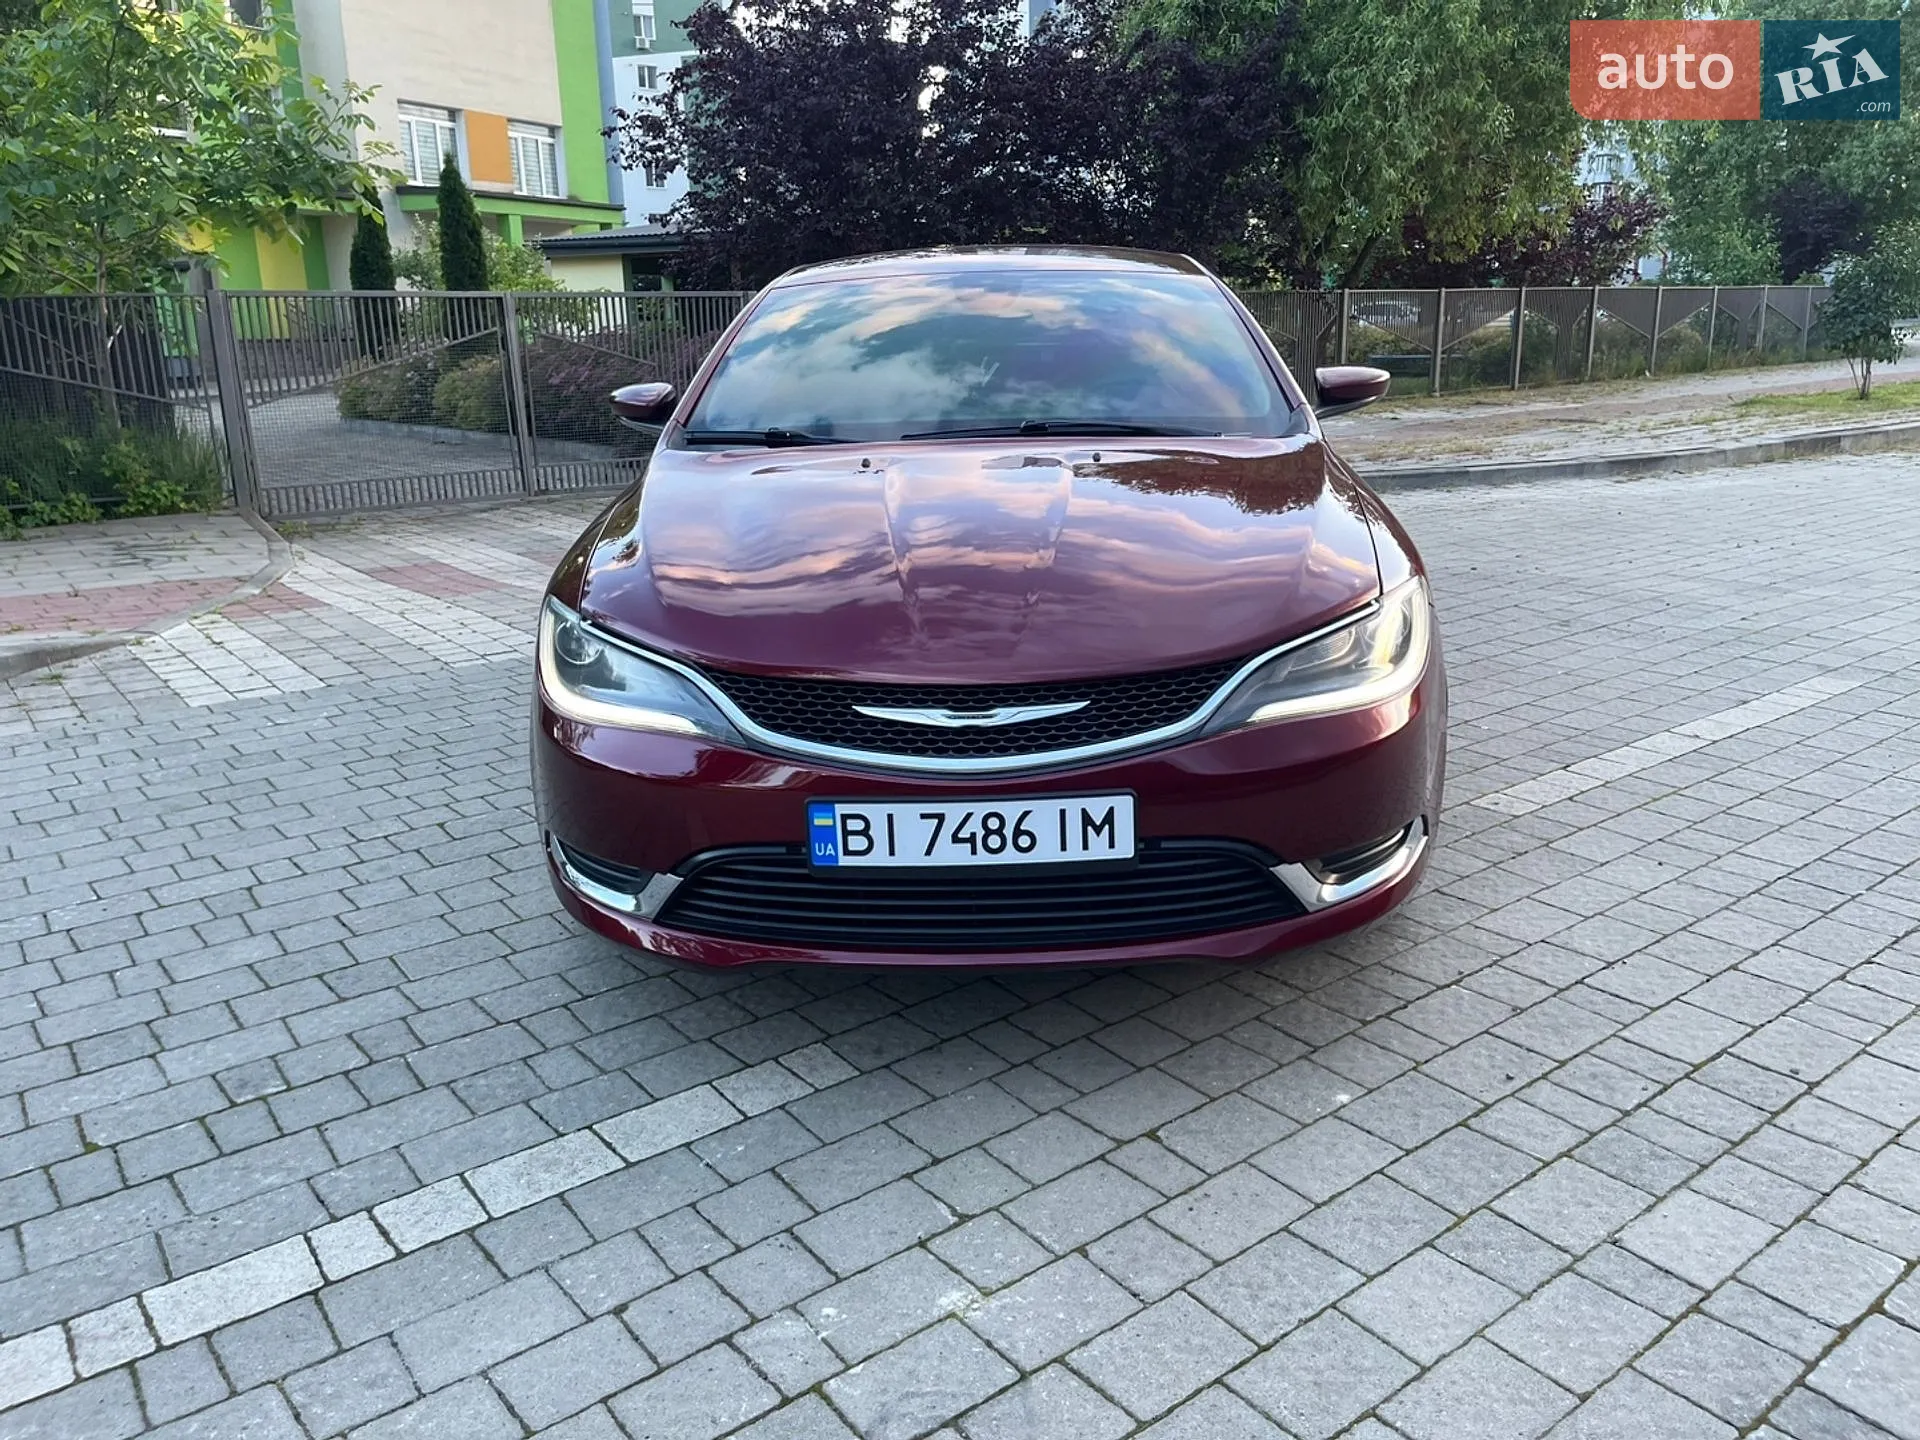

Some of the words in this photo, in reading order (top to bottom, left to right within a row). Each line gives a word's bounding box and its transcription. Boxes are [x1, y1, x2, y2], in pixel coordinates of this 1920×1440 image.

[840, 812, 896, 857] BI
[919, 809, 1037, 857] 7486
[1059, 805, 1116, 852] IM
[815, 843, 836, 857] UA
